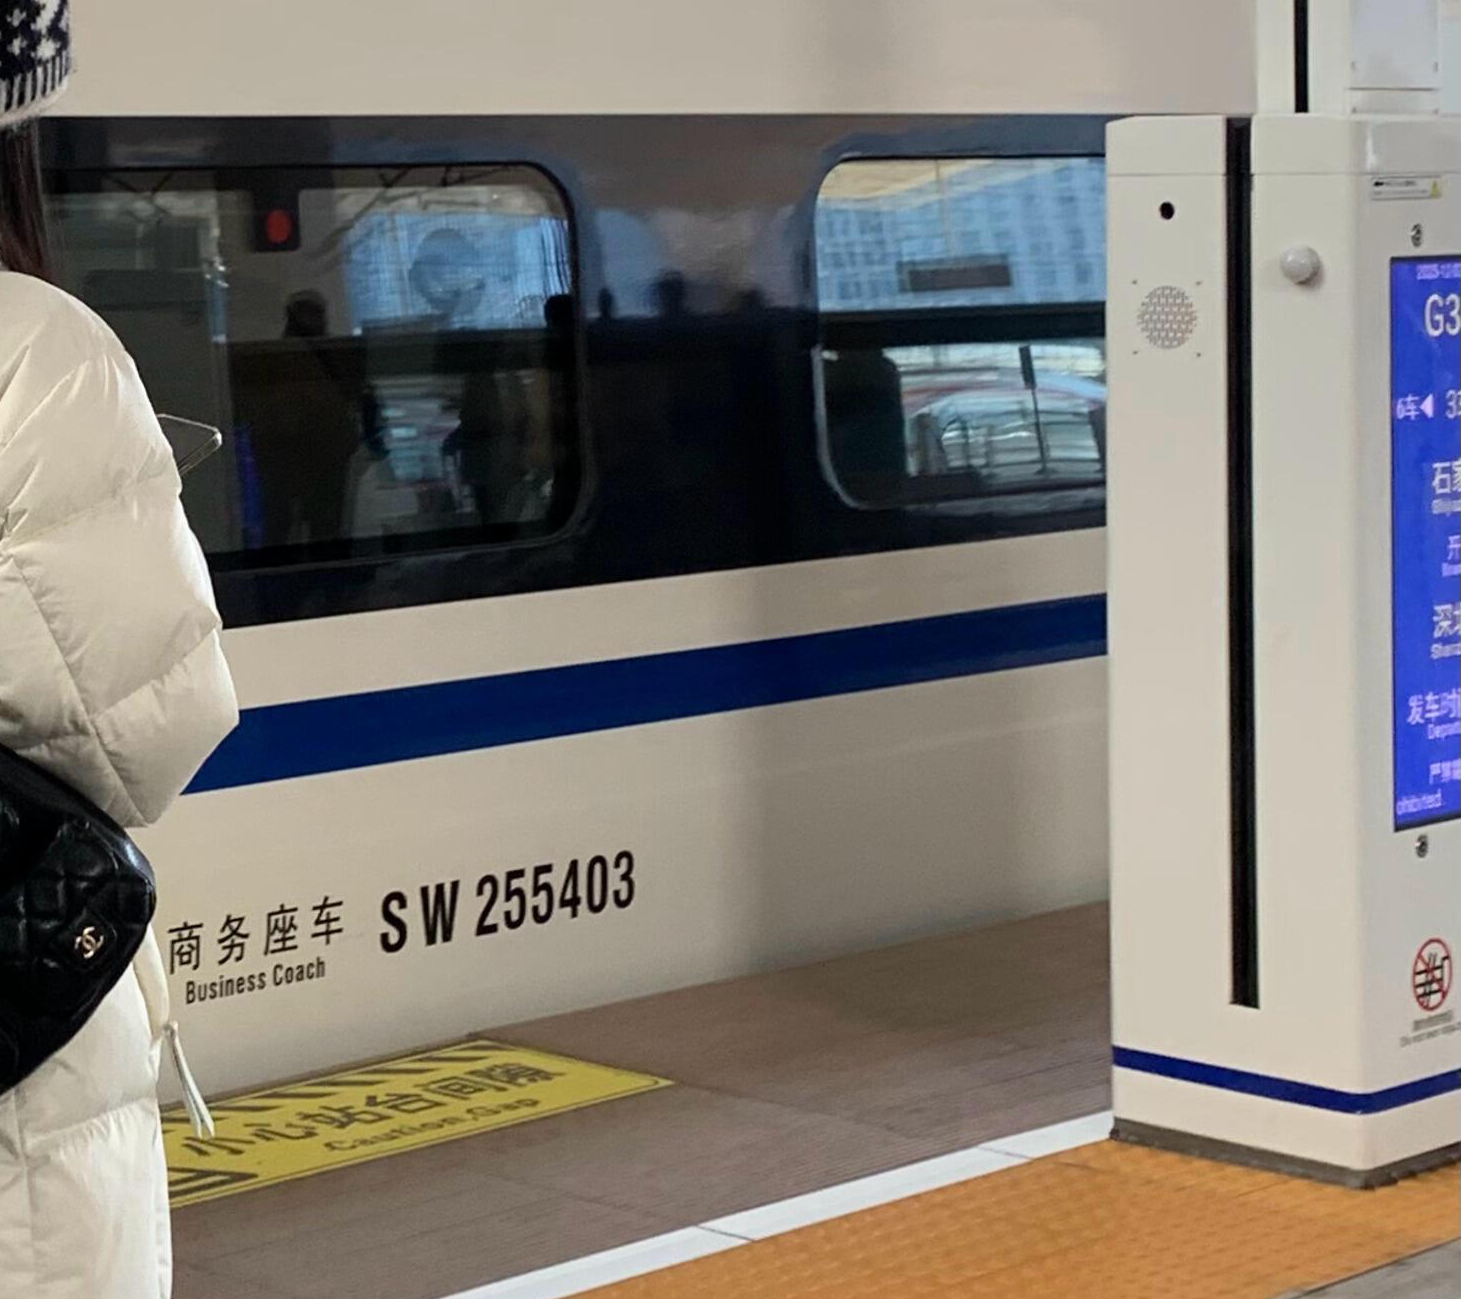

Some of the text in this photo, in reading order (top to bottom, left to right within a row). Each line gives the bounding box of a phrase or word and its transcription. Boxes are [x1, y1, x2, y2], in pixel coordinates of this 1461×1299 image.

[1407, 688, 1461, 725] 发车时
[474, 850, 636, 937] 255403
[167, 895, 344, 976] 商务座车
[185, 955, 326, 1004] Business Coach
[181, 1061, 566, 1157] 小心站台间隙
